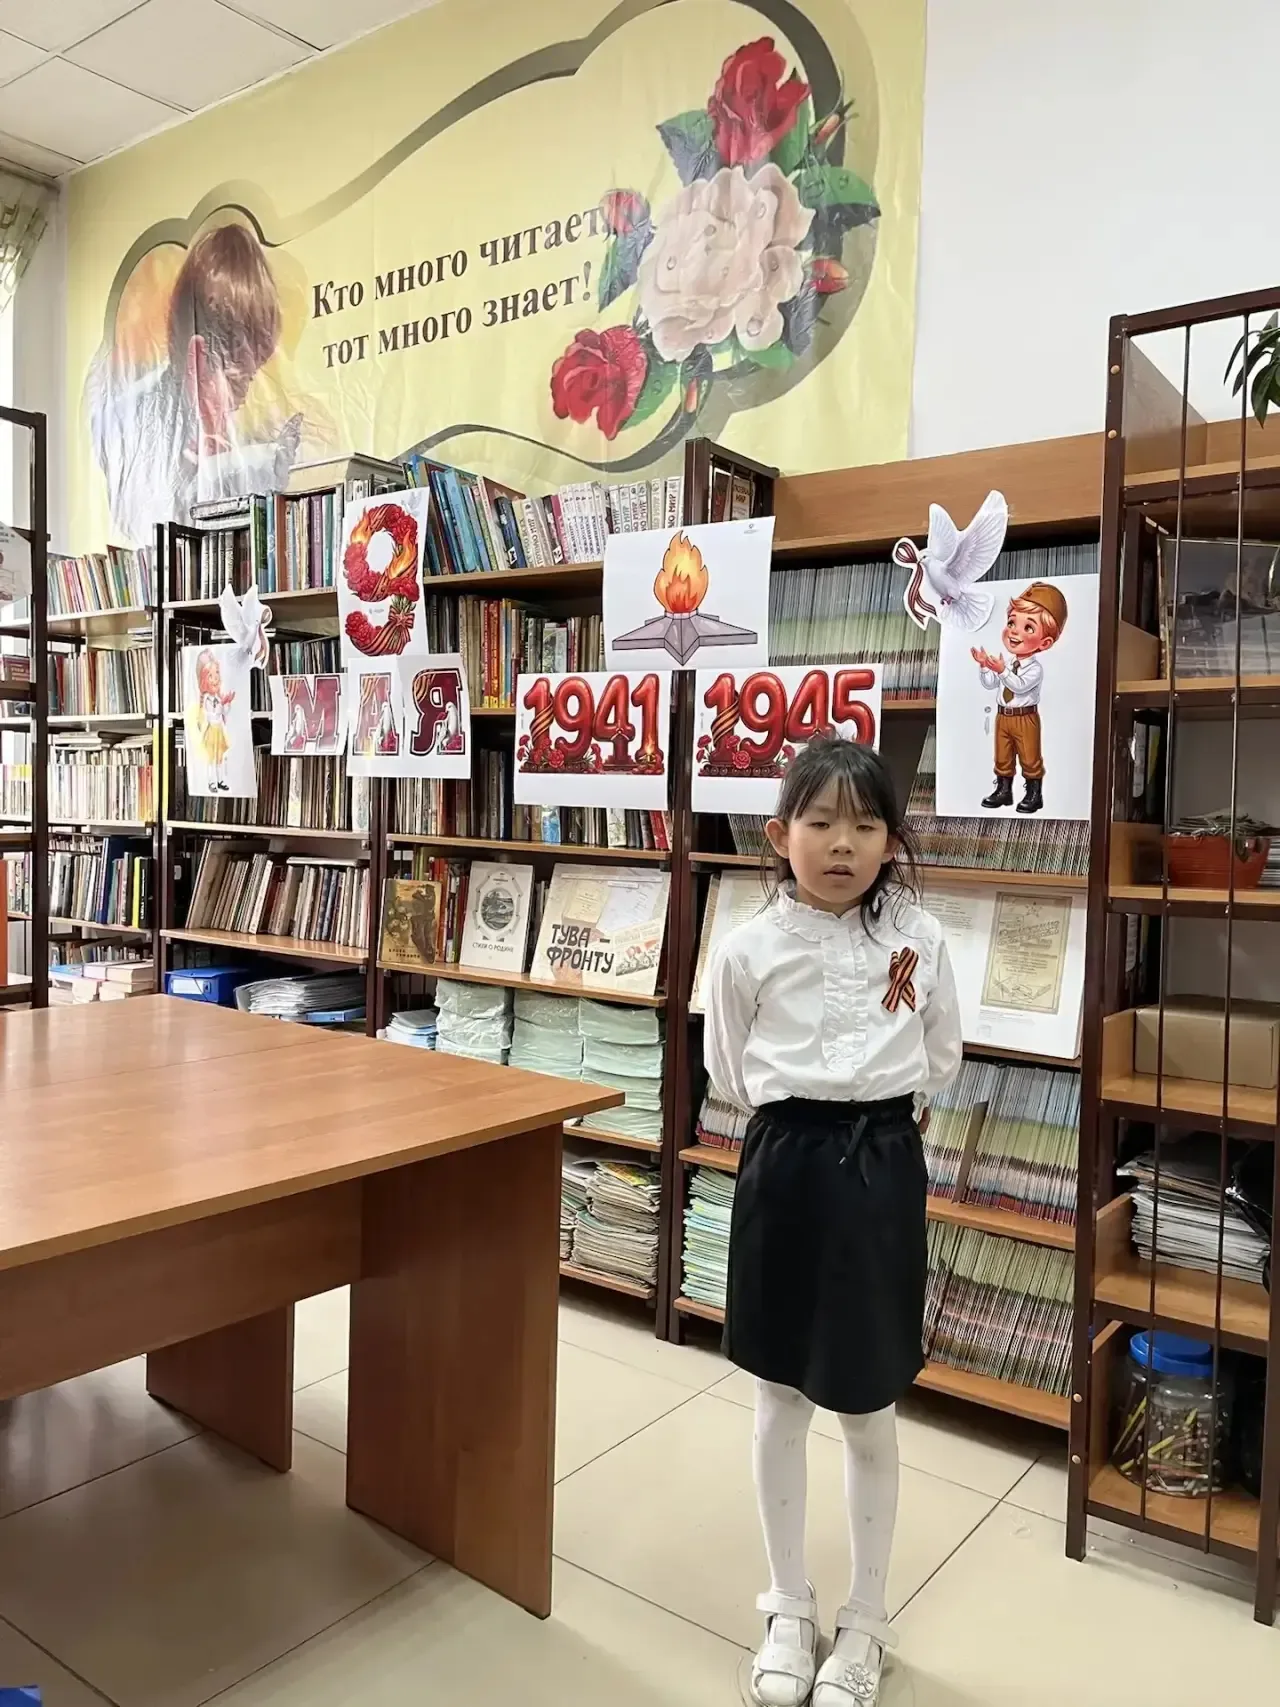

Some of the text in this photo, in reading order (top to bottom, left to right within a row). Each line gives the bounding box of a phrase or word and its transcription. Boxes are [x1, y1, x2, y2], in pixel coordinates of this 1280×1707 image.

[312, 280, 364, 319] Кто
[375, 250, 468, 300] много
[322, 261, 592, 368] тот много знает!
[343, 503, 420, 657] 9
[522, 672, 664, 767] 1941
[703, 669, 876, 765] 1945
[546, 946, 615, 974] ФРОНТУ
[552, 924, 592, 948] ТУВА
